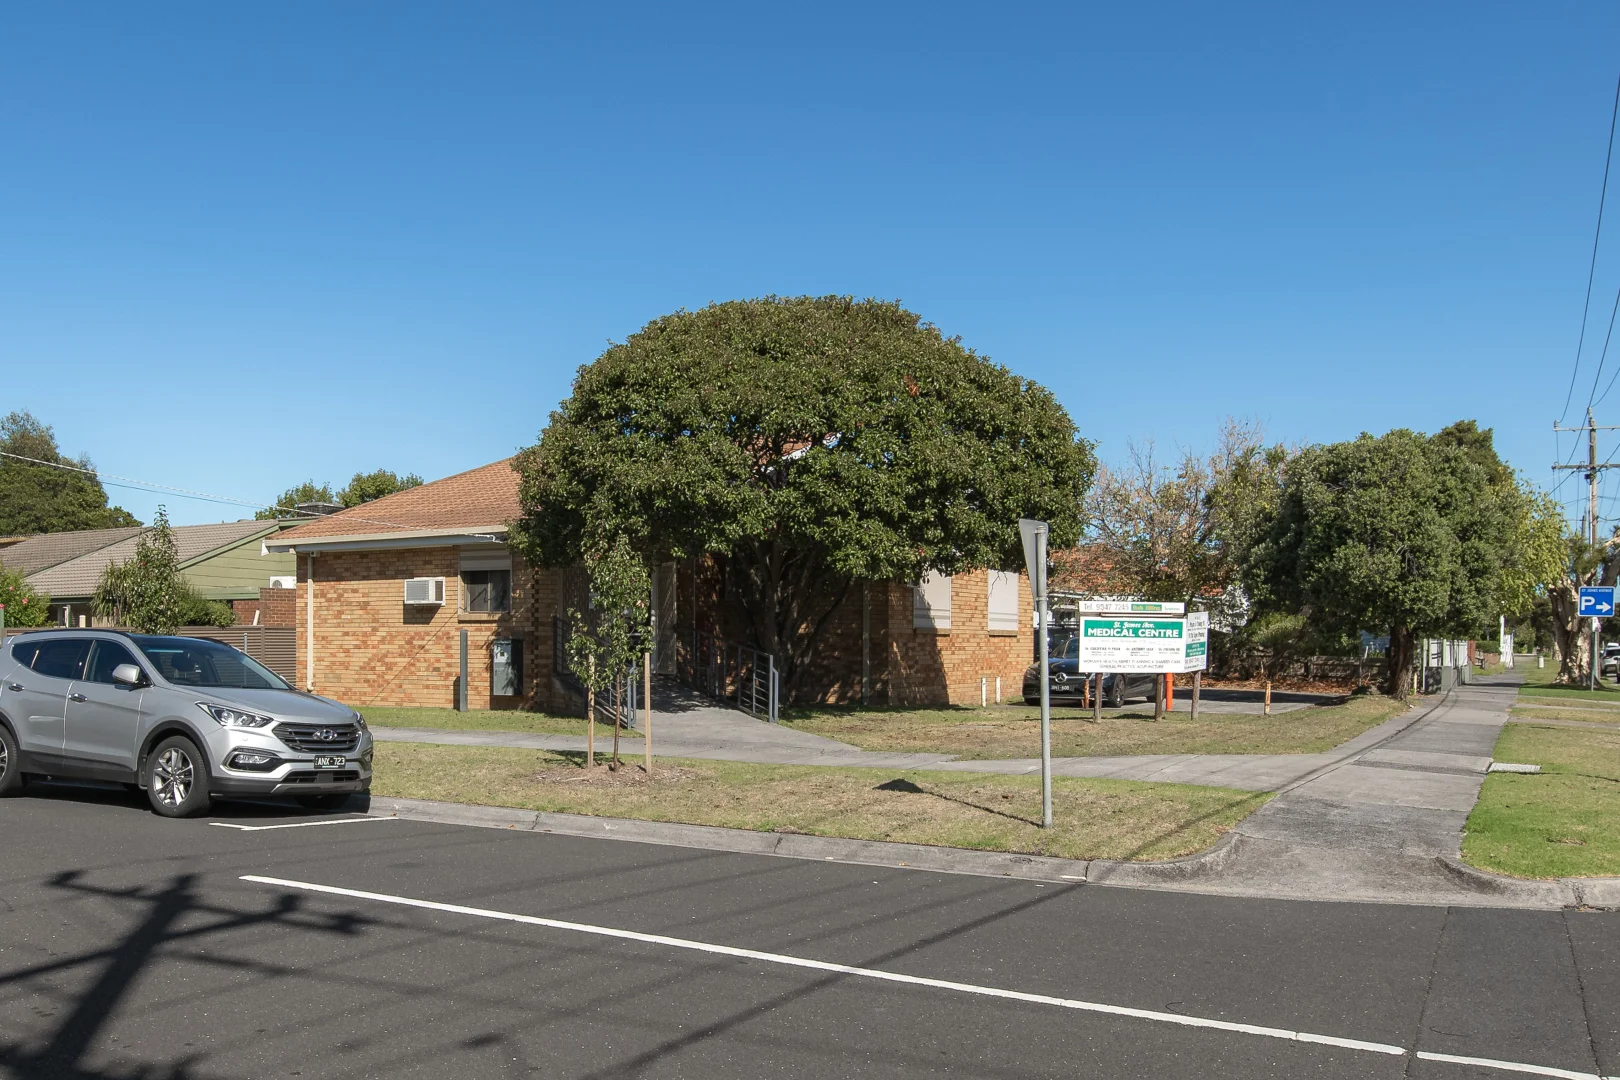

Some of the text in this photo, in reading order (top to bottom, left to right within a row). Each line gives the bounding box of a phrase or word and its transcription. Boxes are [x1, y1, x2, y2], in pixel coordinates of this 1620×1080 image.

[1581, 596, 1596, 610] P
[1087, 628, 1135, 637] MEDICAL
[1138, 629, 1179, 637] CENTRE
